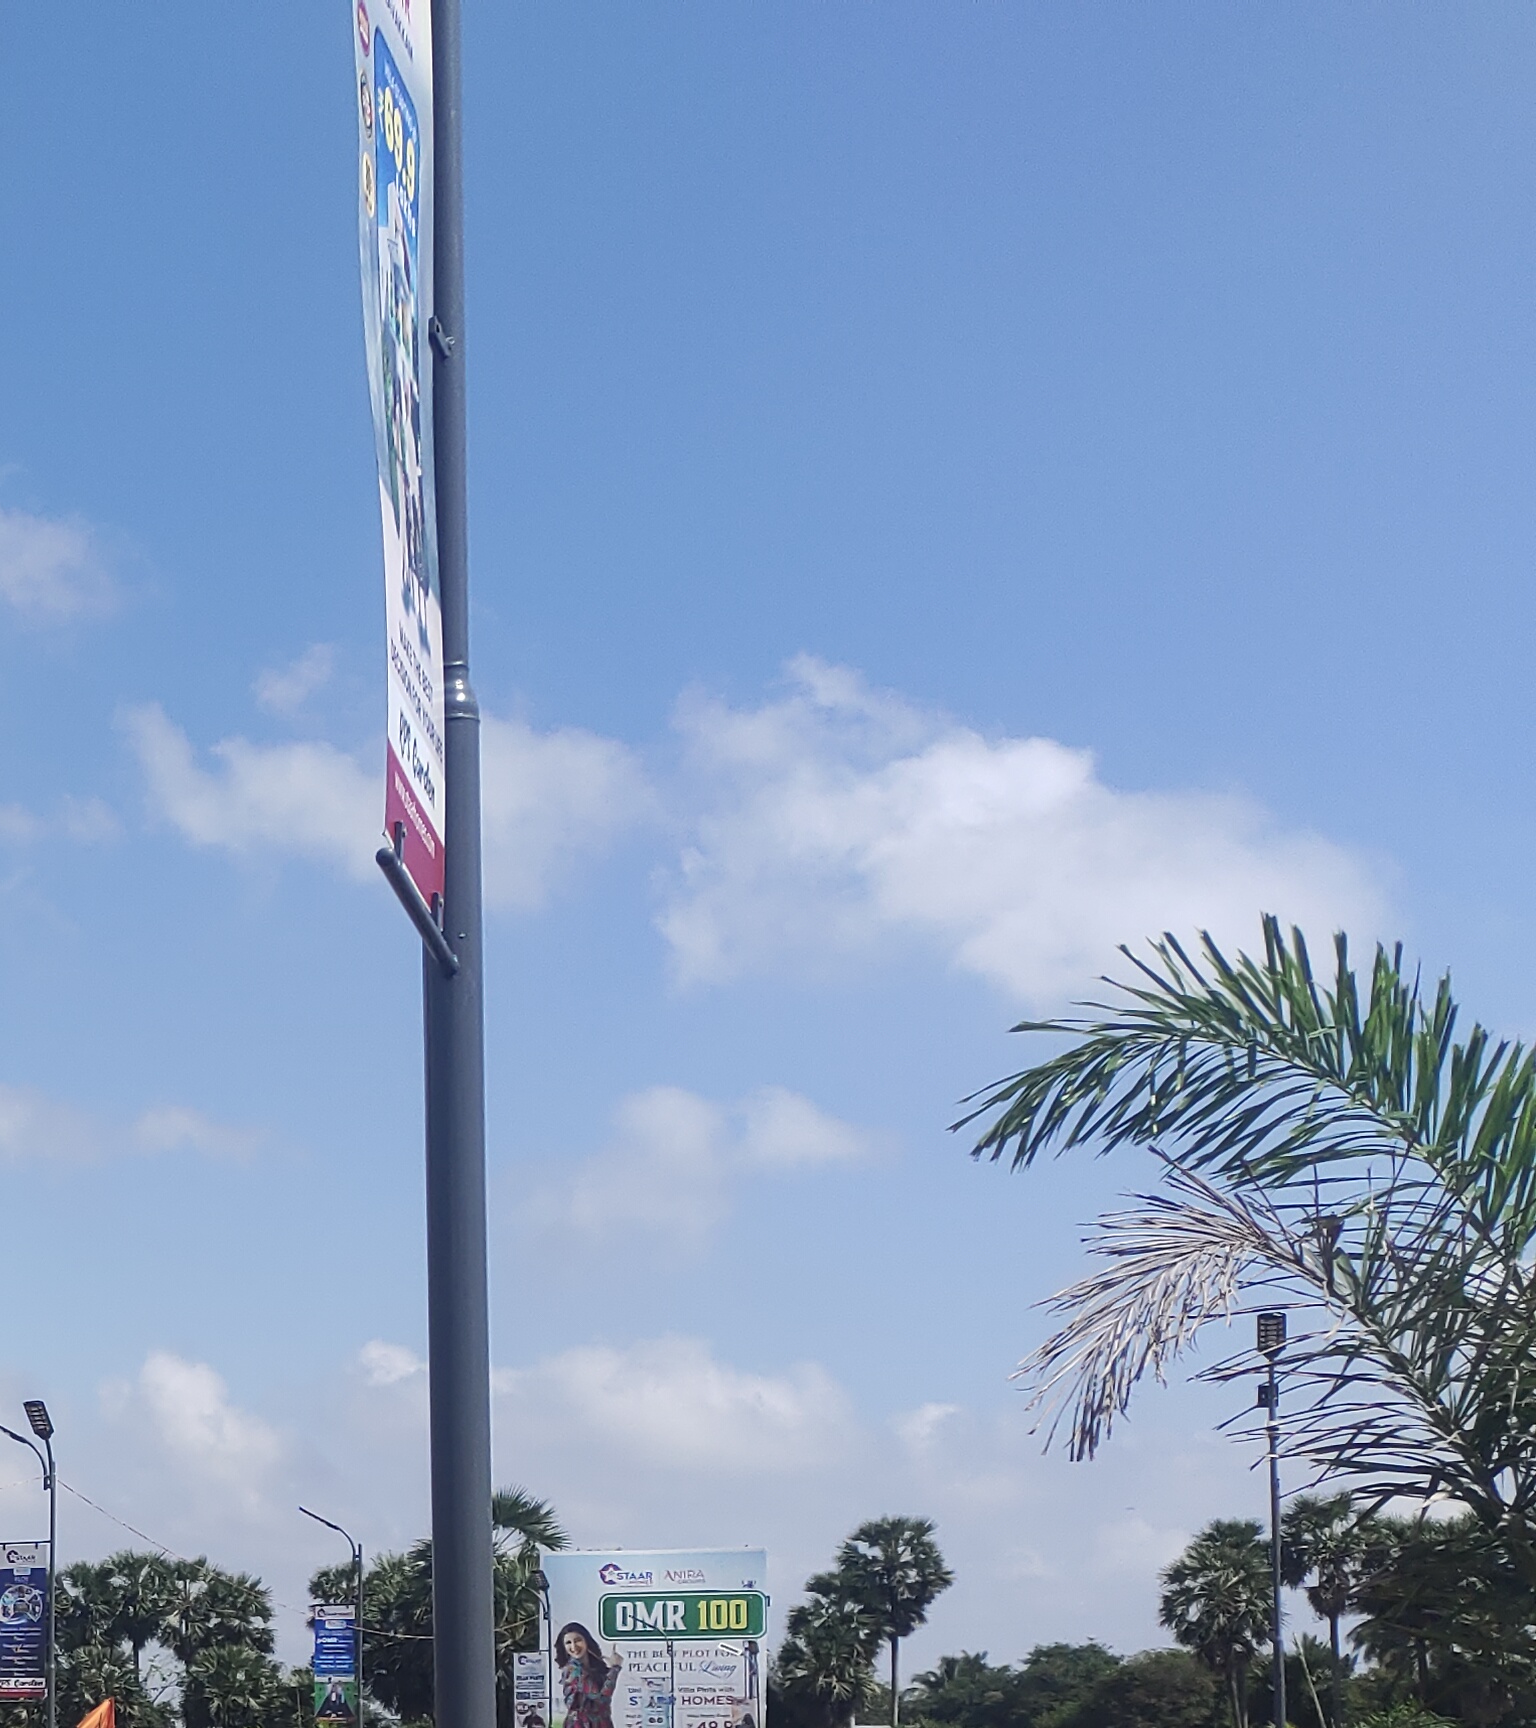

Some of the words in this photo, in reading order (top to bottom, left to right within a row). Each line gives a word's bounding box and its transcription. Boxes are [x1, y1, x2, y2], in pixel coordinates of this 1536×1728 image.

[616, 1571, 653, 1581] STAAR
[664, 1570, 705, 1581] ANIRA
[616, 1600, 687, 1632] OMR
[697, 1599, 748, 1631] 100
[627, 1650, 647, 1659] THE
[682, 1649, 711, 1658] PLOT
[681, 1696, 734, 1706] HOMES
